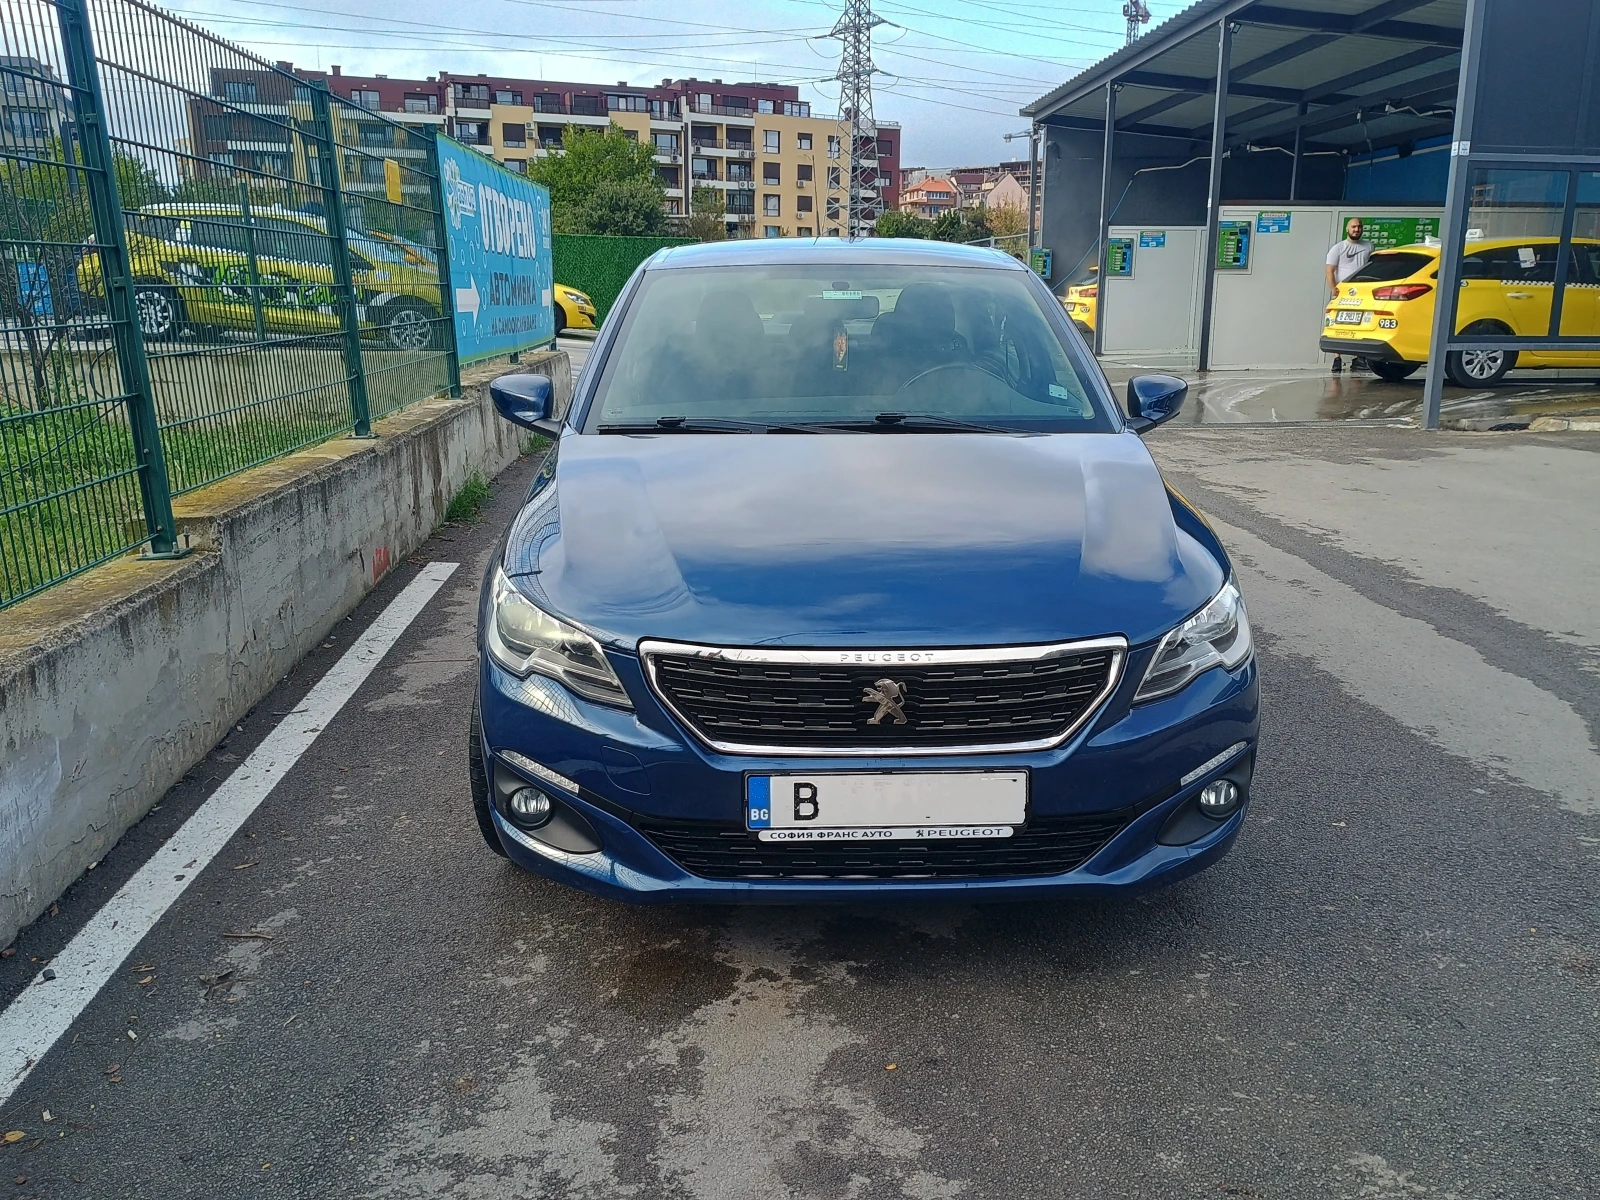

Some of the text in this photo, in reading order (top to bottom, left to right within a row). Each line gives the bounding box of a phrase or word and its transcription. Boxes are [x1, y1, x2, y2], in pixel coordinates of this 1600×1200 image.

[478, 182, 537, 260] ОТВОРЕНО
[489, 270, 537, 306] АВТОМИВКА
[1380, 319, 1397, 328] 983
[840, 653, 934, 662] PEUGEOT
[750, 782, 820, 821] BG B
[816, 831, 858, 839] ФРАНС
[861, 830, 893, 838] АУТО
[927, 828, 1004, 837] PEUGEOT
